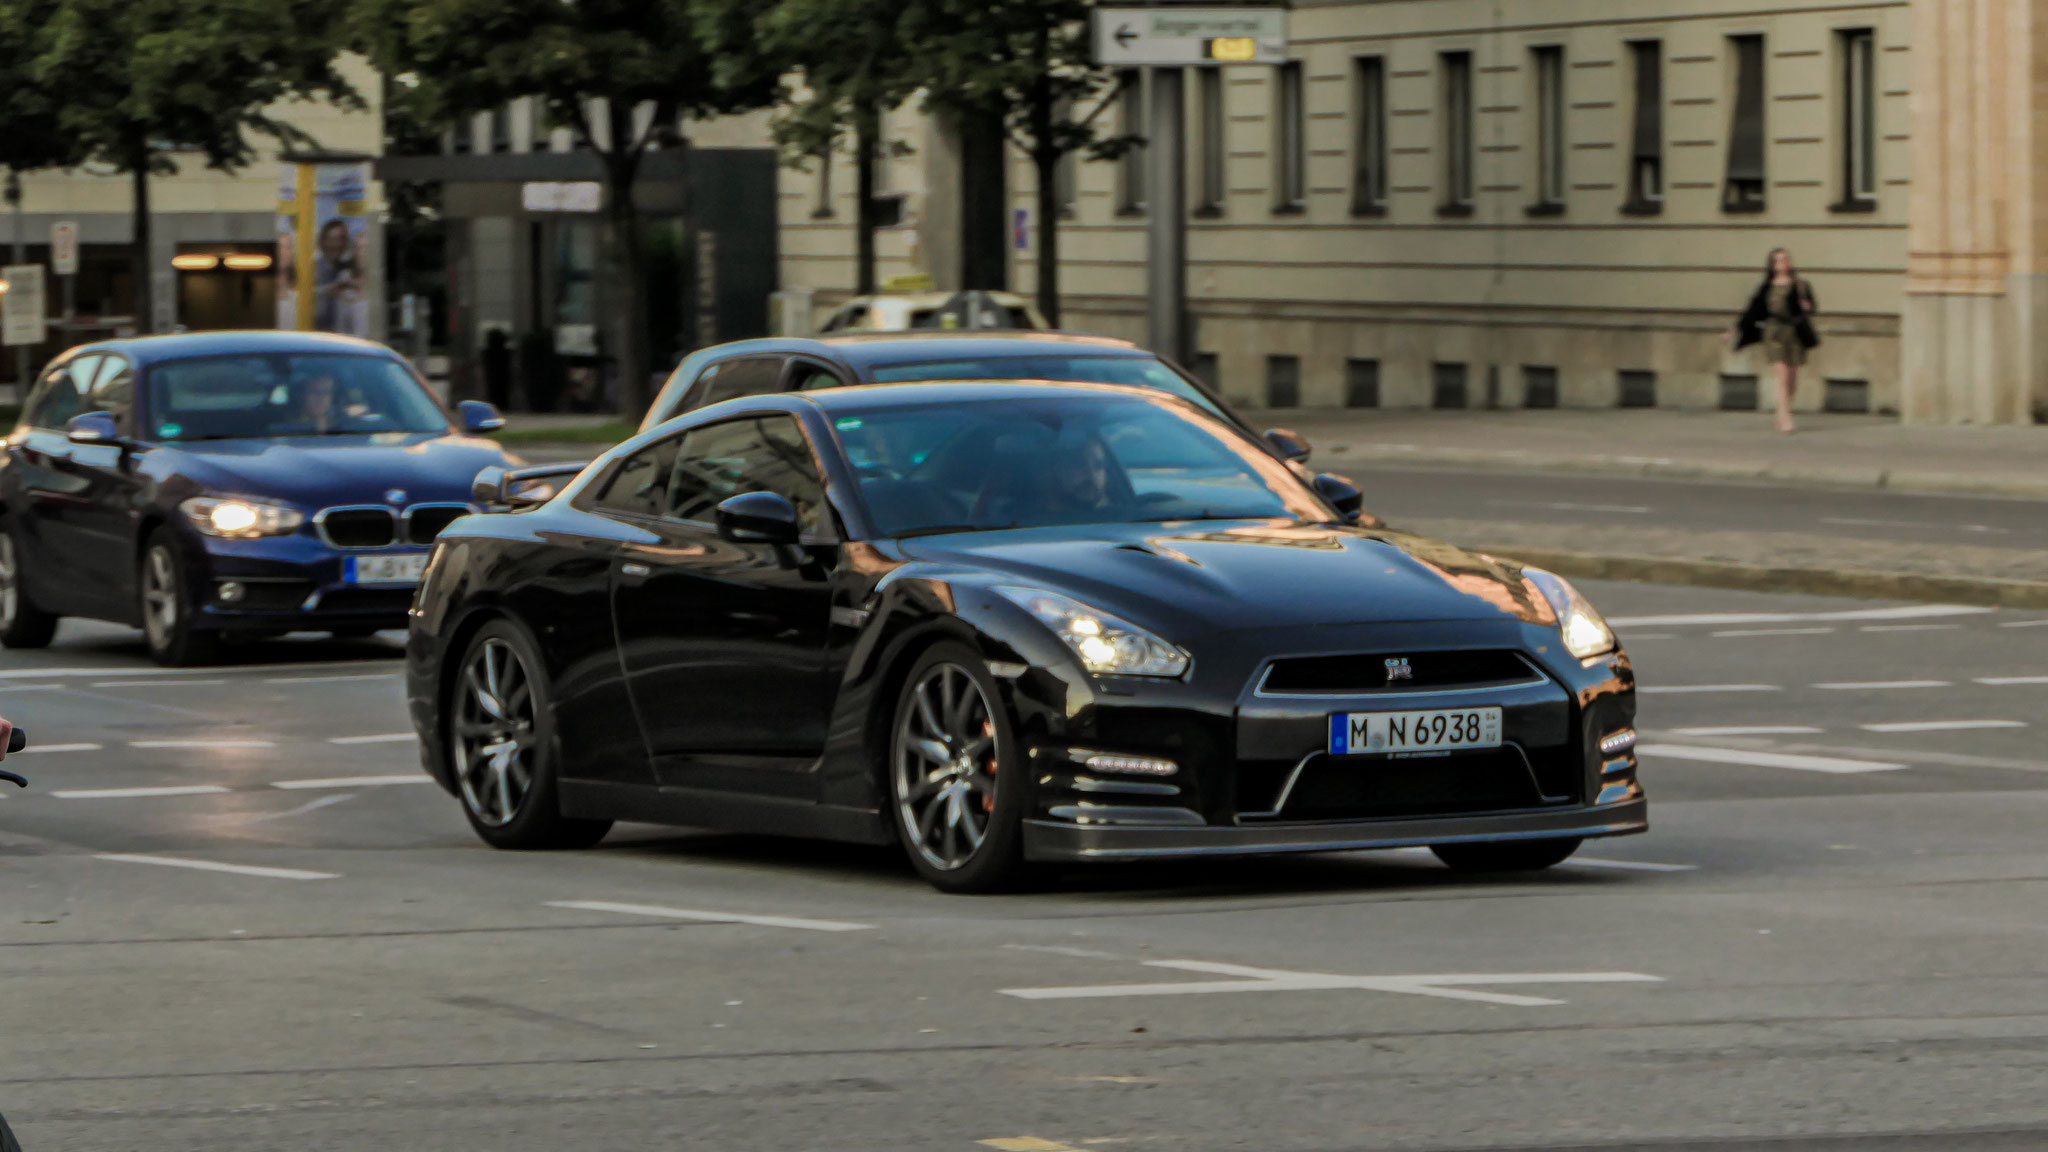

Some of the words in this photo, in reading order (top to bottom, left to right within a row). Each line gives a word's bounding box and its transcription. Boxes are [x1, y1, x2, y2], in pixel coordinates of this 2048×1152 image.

[1351, 718, 1368, 747] M
[1389, 717, 1406, 746] N
[1414, 713, 1480, 745] 6938
